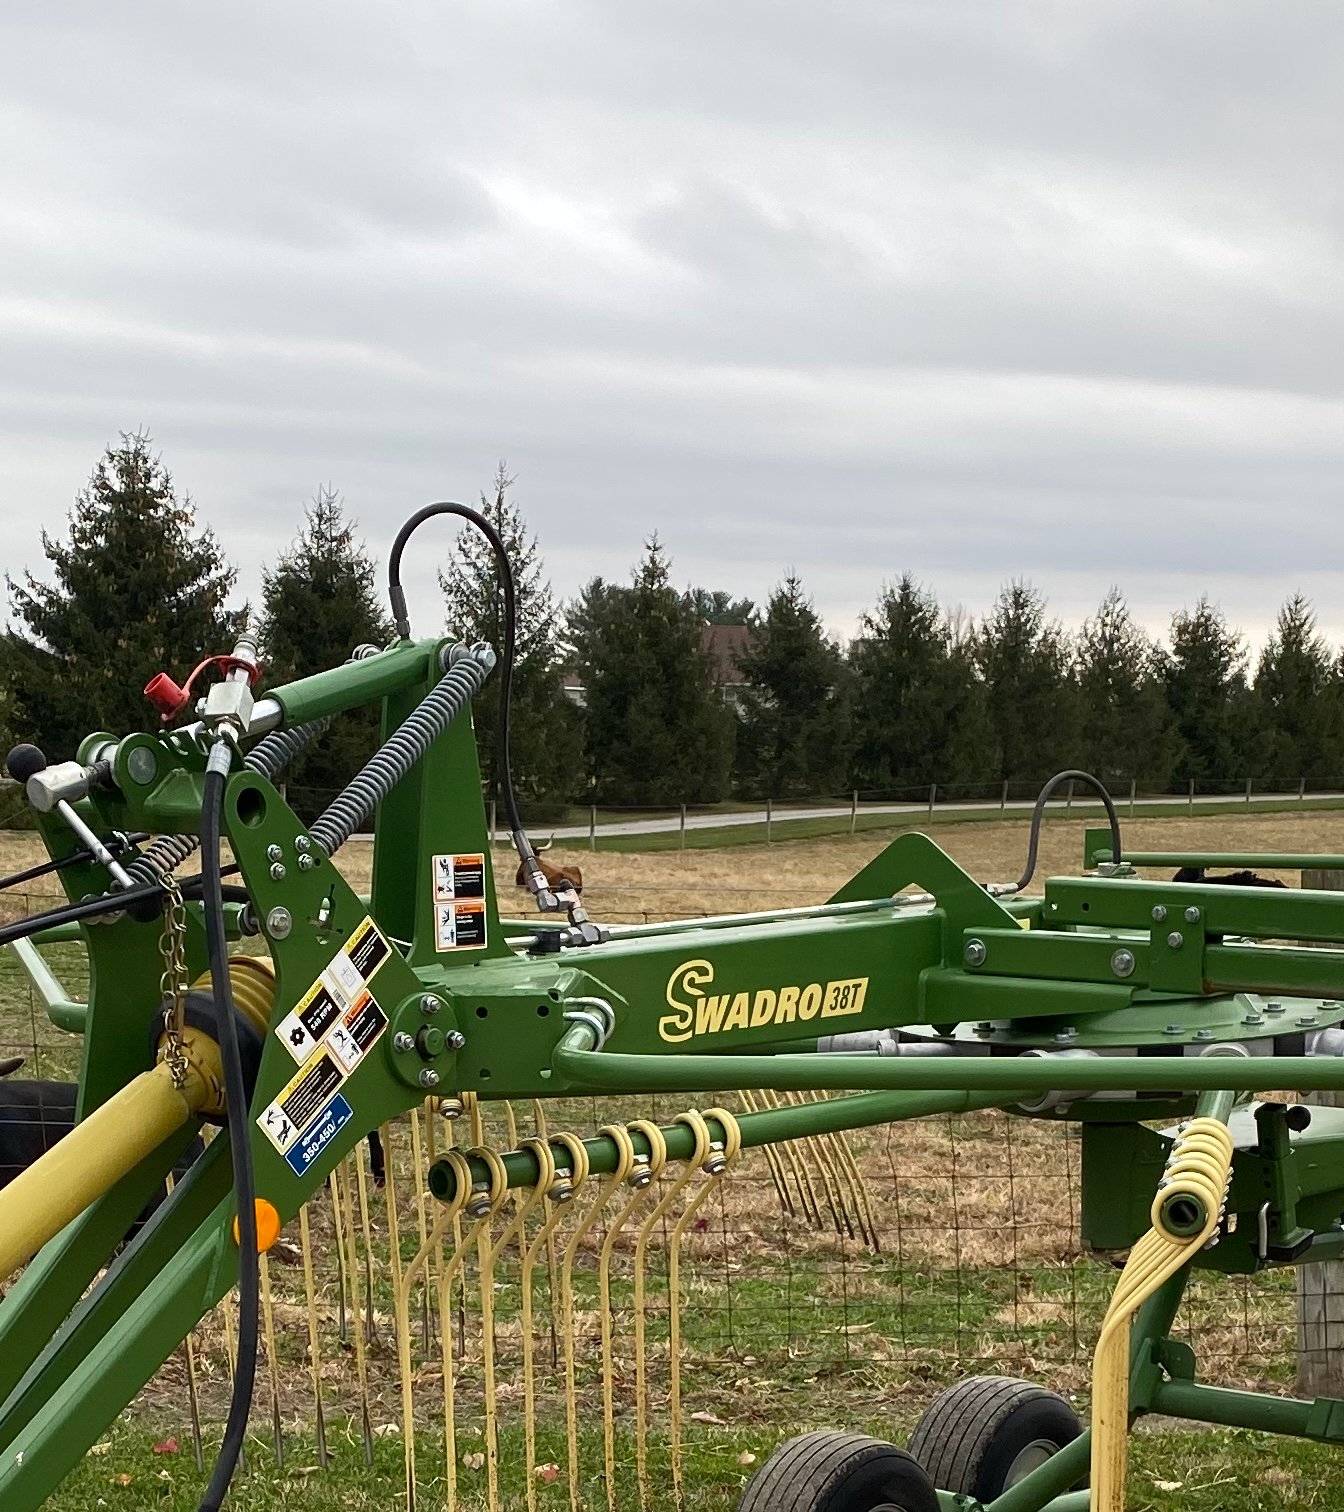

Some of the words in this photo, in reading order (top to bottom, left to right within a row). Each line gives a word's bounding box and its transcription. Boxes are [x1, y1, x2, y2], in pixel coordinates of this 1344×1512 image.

[303, 982, 323, 1007] CAUTION
[658, 959, 823, 1043] SWADRO
[829, 982, 863, 1012] 38T
